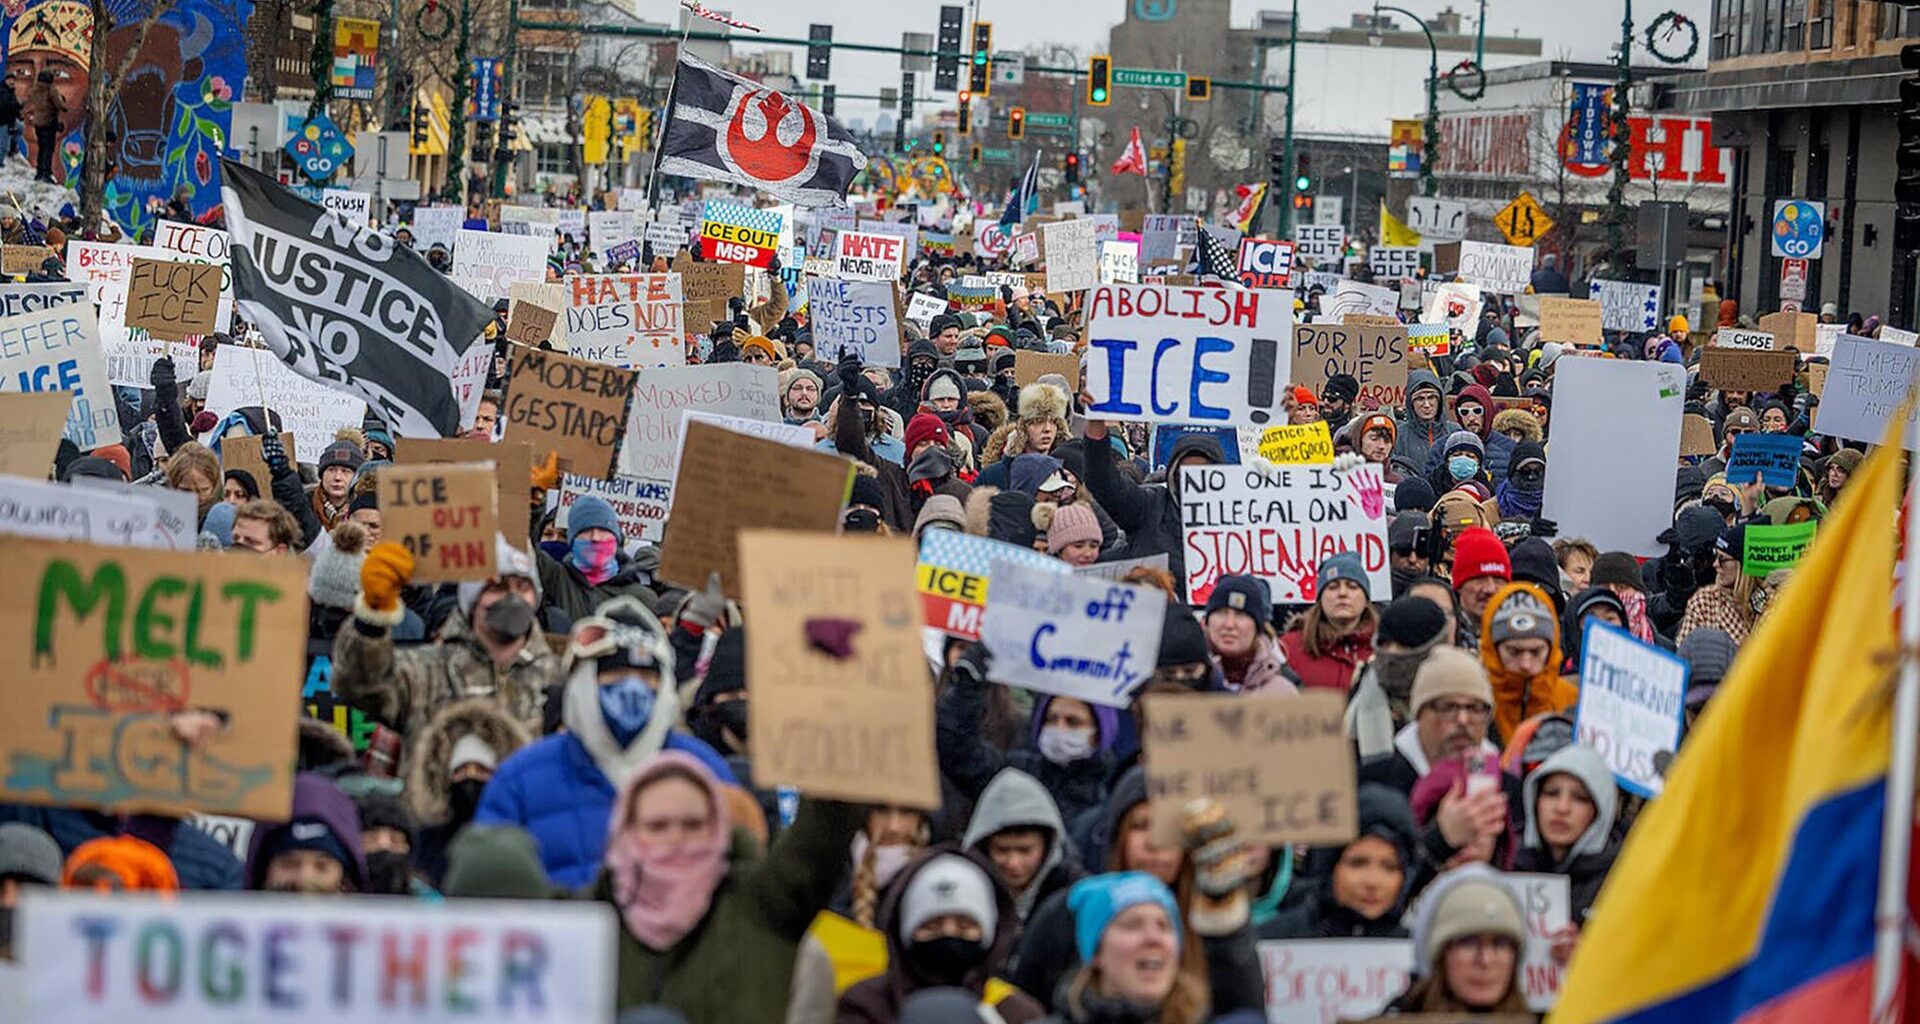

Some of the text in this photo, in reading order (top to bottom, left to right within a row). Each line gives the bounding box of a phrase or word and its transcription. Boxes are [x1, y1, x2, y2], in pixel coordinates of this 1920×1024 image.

[1154, 74, 1171, 84] Av
[1174, 75, 1182, 84] S
[350, 89, 373, 99] STREET
[1583, 87, 1598, 161] MIDTOWN
[306, 157, 332, 172] GO
[325, 196, 366, 213] CRUSH
[161, 223, 206, 256] ICE
[703, 221, 778, 248] ICE OUT
[1299, 228, 1341, 241] ICE
[715, 242, 758, 261] MSP
[842, 233, 900, 262] HATE
[1242, 241, 1290, 275] ICE
[1300, 242, 1340, 255] OUT
[1374, 251, 1417, 264] ICE
[1784, 239, 1810, 255] GO
[840, 259, 897, 277] NEVER MADE
[1102, 252, 1138, 268] FUCK
[1375, 264, 1417, 278] OUT
[1462, 253, 1530, 284] CRIMINALS
[88, 269, 121, 281] THE
[132, 262, 210, 298] FUCK
[987, 273, 1002, 286] ICE
[1005, 274, 1024, 287] OUT
[1241, 273, 1290, 289] OUT
[572, 275, 671, 307] HATE
[810, 281, 851, 299] MAKE
[970, 296, 990, 304] OUT
[137, 293, 204, 324] ICE
[812, 302, 887, 325] FASCISTS
[914, 298, 941, 309] ICE OUT
[1090, 287, 1260, 329] ABOLISH
[566, 303, 631, 333] DOES
[634, 302, 682, 332] NOT
[516, 322, 542, 346] ICE
[815, 322, 876, 345] AFRAID
[1423, 335, 1446, 344] OUT
[1733, 333, 1774, 350] CHOSE
[570, 346, 628, 361] MAKE
[815, 342, 866, 362] AGAN
[1296, 327, 1404, 364] POR LOS
[18, 359, 84, 397] ICE
[512, 354, 634, 399] MODERN
[1087, 336, 1279, 424] ICE!
[508, 393, 618, 447] GESTAPO
[1308, 425, 1322, 438] 4
[1299, 440, 1330, 461] GOOD
[1733, 459, 1773, 468] ABOLISH
[1184, 467, 1342, 493] NO ONE IS
[389, 477, 447, 508] ICE
[432, 507, 482, 530] OUT
[635, 501, 665, 520] GOOD
[1184, 499, 1348, 527] ILLEGAL ON
[403, 533, 487, 570] OF MN
[1188, 527, 1300, 579] STOLEN
[1749, 545, 1789, 554] PROTECT
[1749, 553, 1795, 563] ABOLISH
[927, 568, 980, 598] ICE
[33, 557, 284, 669] MELT
[1085, 586, 1135, 623] off
[1030, 623, 1138, 698] Community
[1263, 793, 1336, 832] ICE
[72, 916, 553, 1016] TOGETHER
[1264, 948, 1410, 1006] Brown
